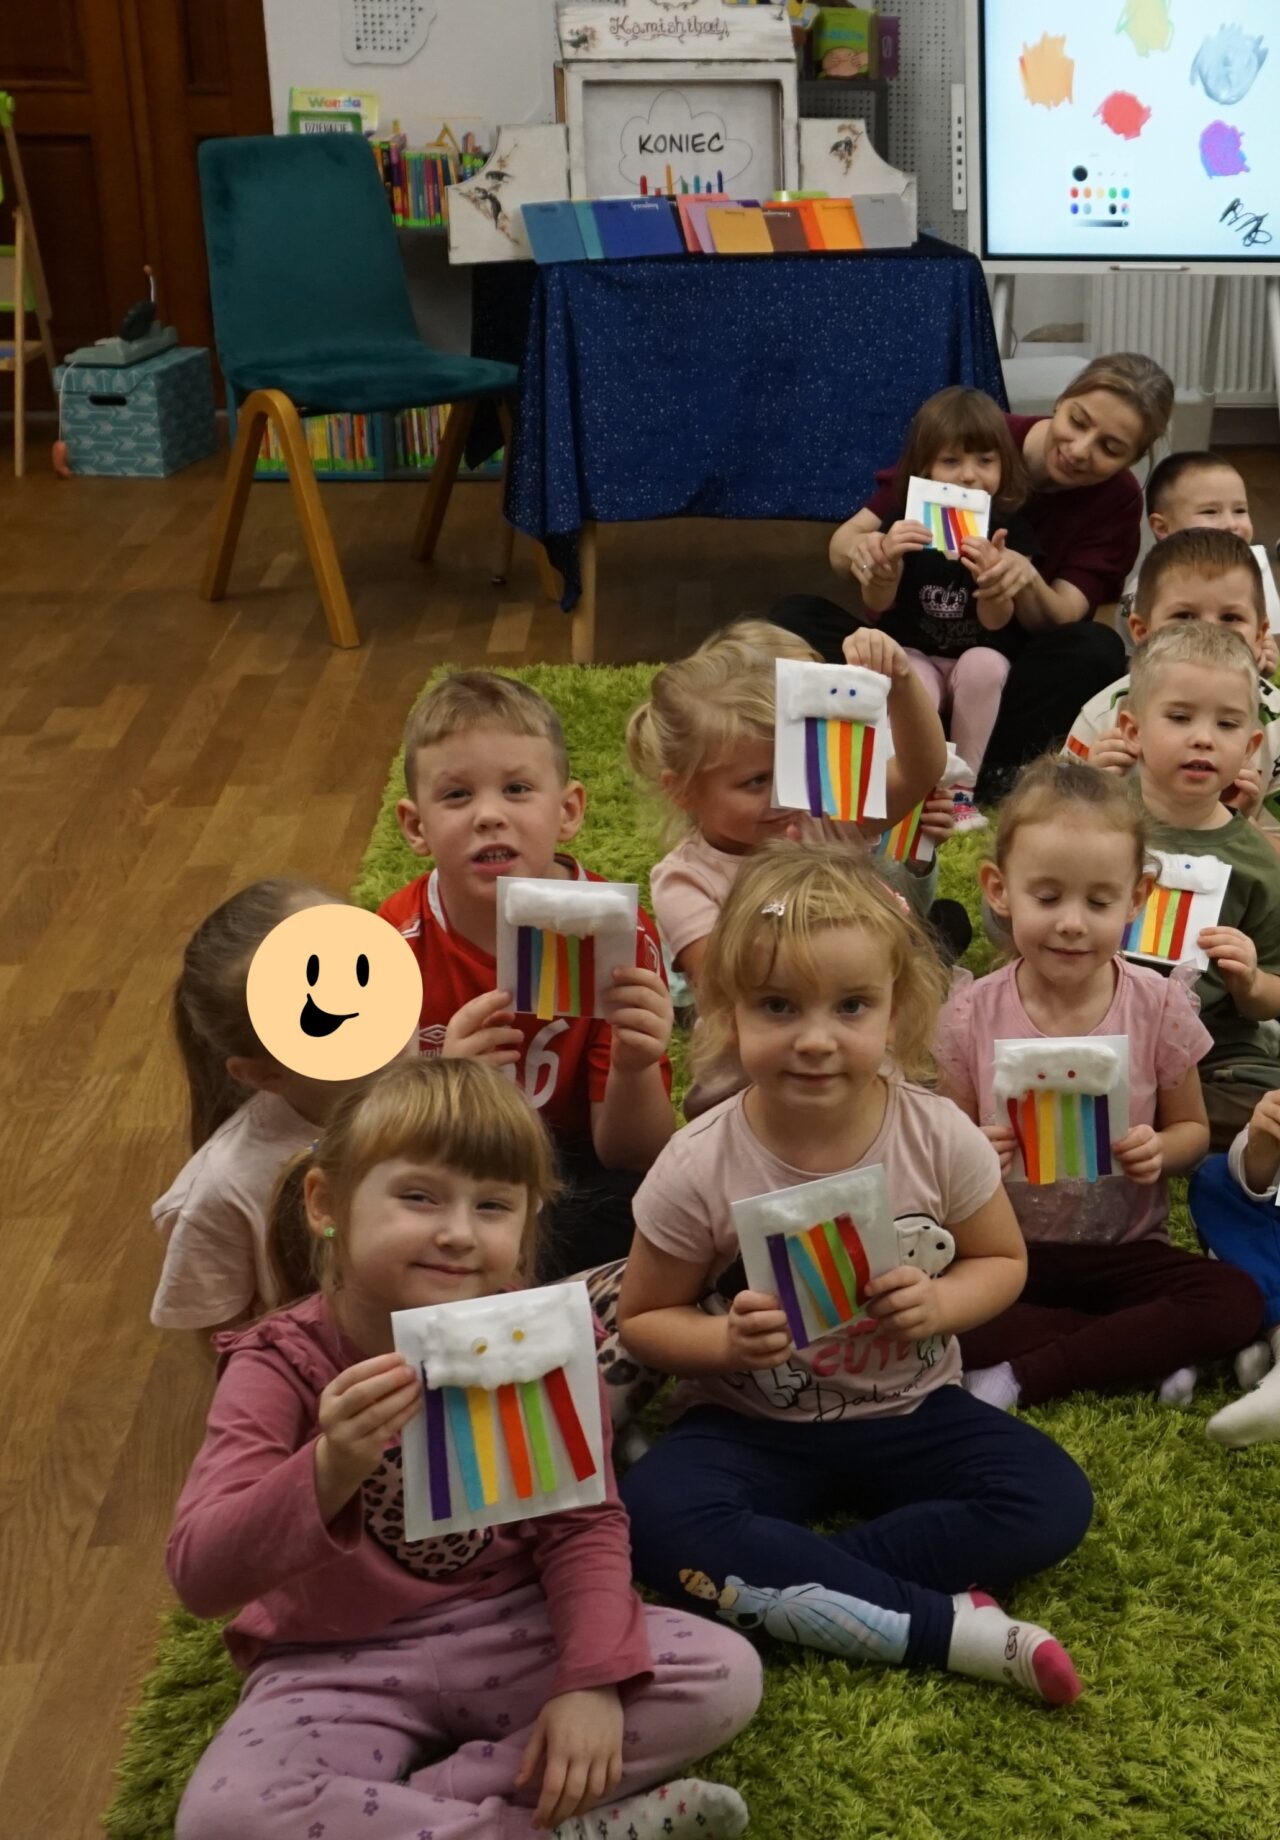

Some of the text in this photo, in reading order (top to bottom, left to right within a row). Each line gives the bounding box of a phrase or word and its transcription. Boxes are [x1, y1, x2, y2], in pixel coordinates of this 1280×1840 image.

[609, 15, 724, 36] Kamishibai
[638, 132, 725, 154] KONIEC
[501, 1018, 571, 1110] 6
